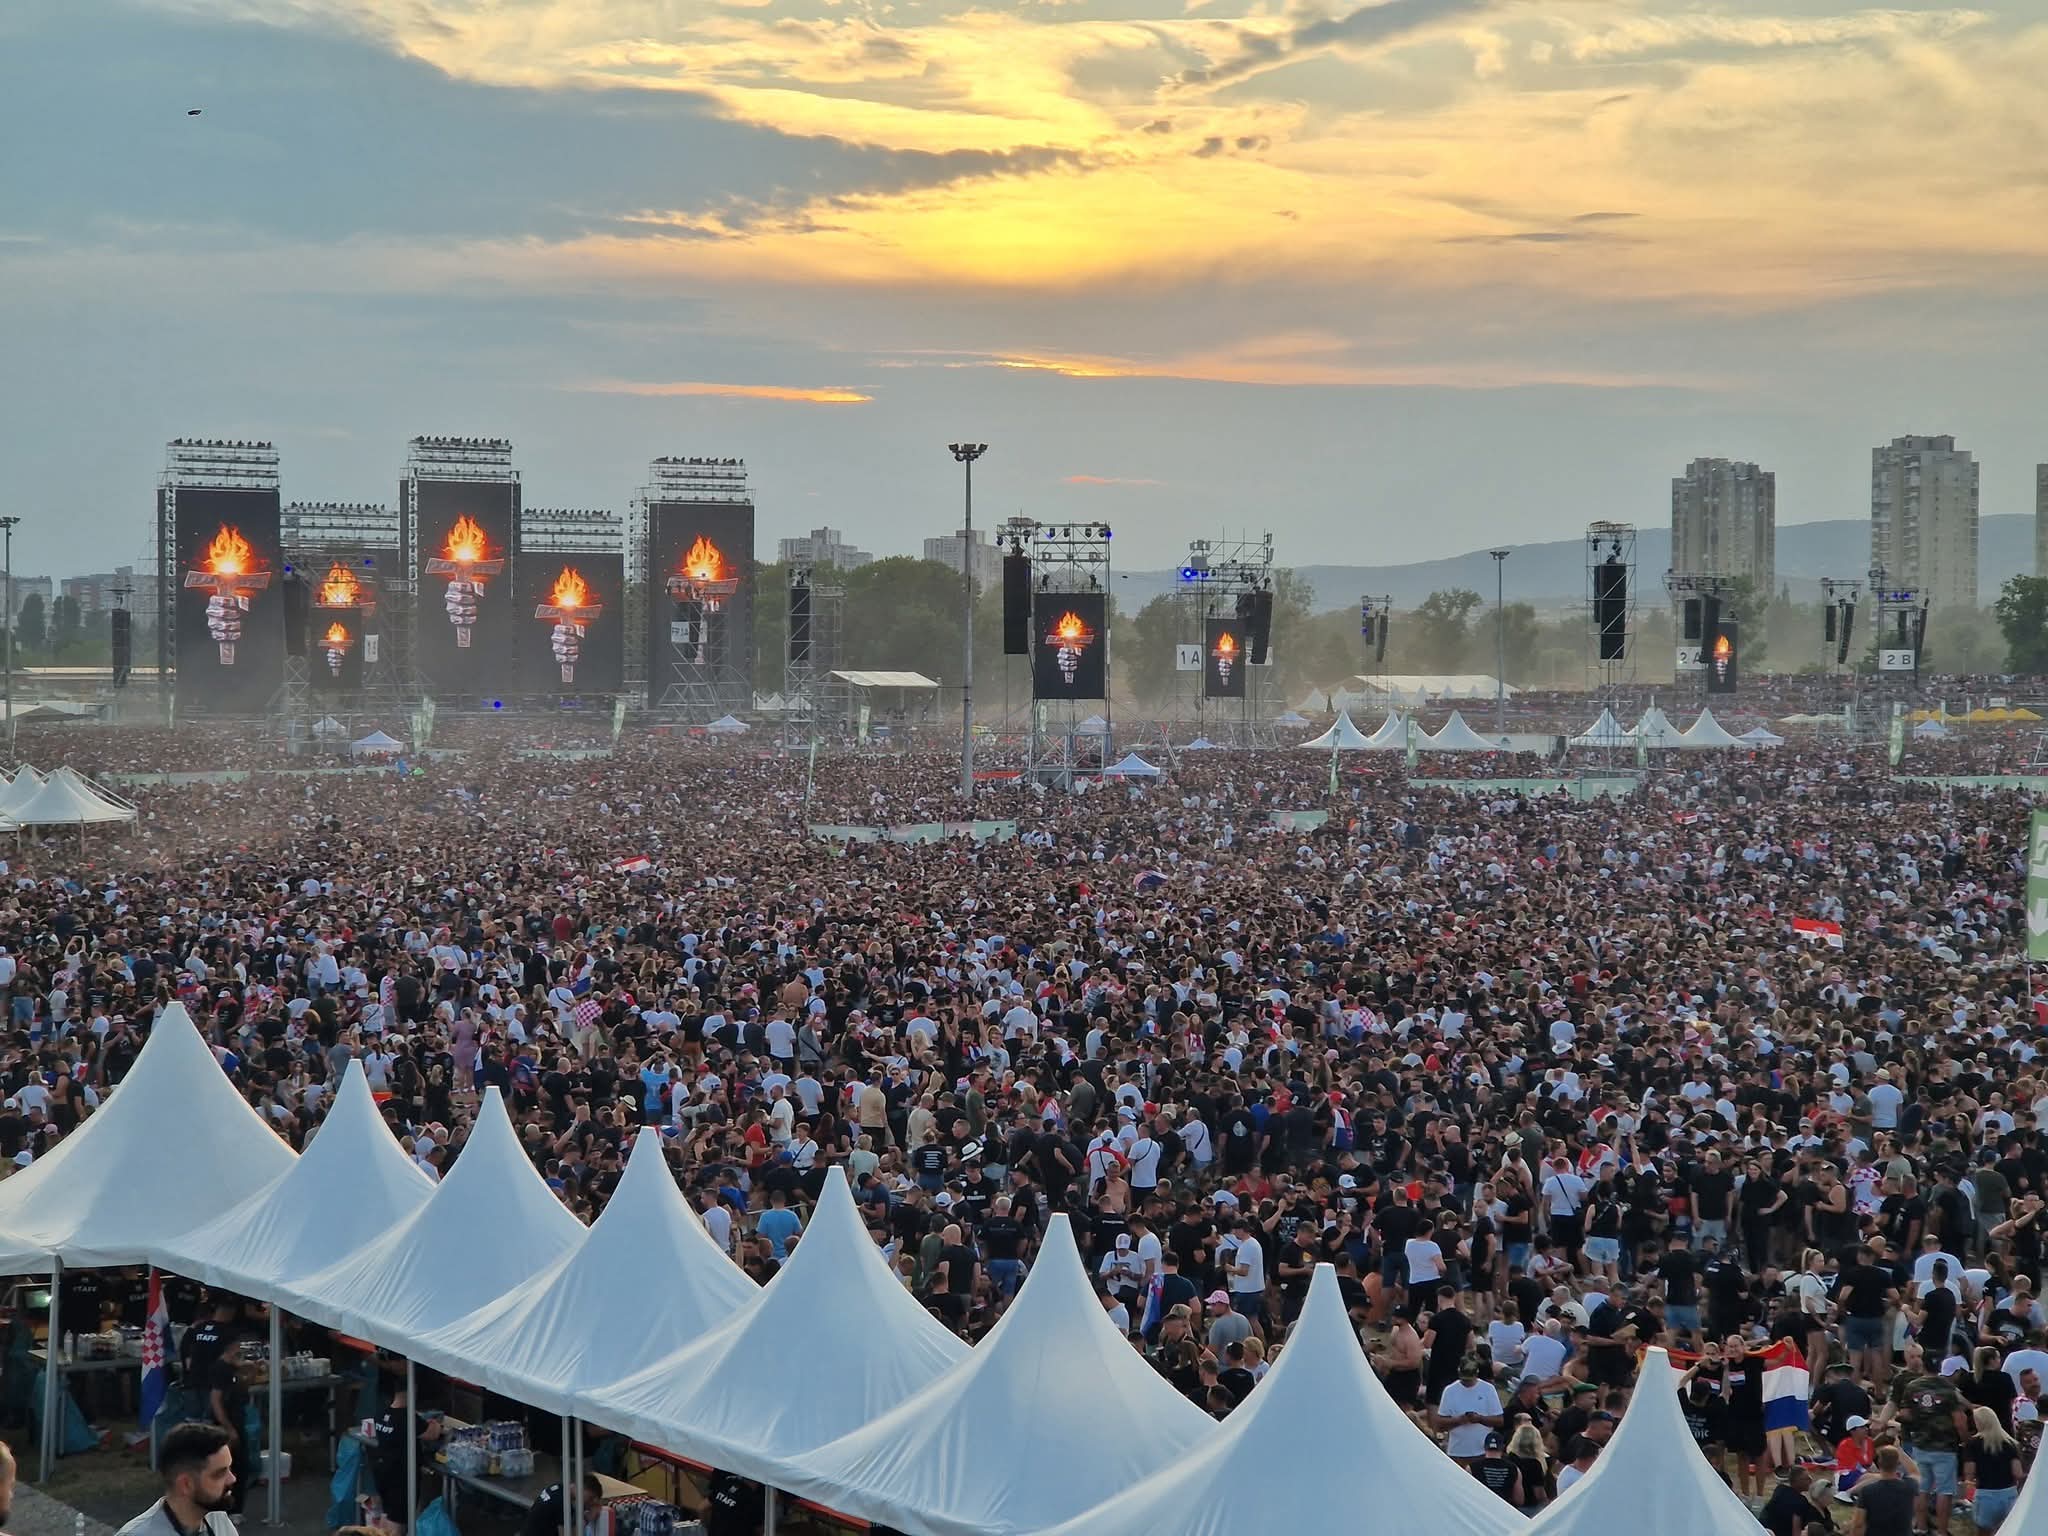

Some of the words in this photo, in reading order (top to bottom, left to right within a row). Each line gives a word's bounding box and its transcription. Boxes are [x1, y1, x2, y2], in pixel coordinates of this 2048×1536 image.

[1191, 650, 1200, 665] A
[1680, 651, 1688, 665] 2
[1887, 654, 1896, 665] 2
[1902, 654, 1911, 665] B
[196, 1333, 219, 1342] STAFF
[715, 1491, 737, 1507] STAFF
